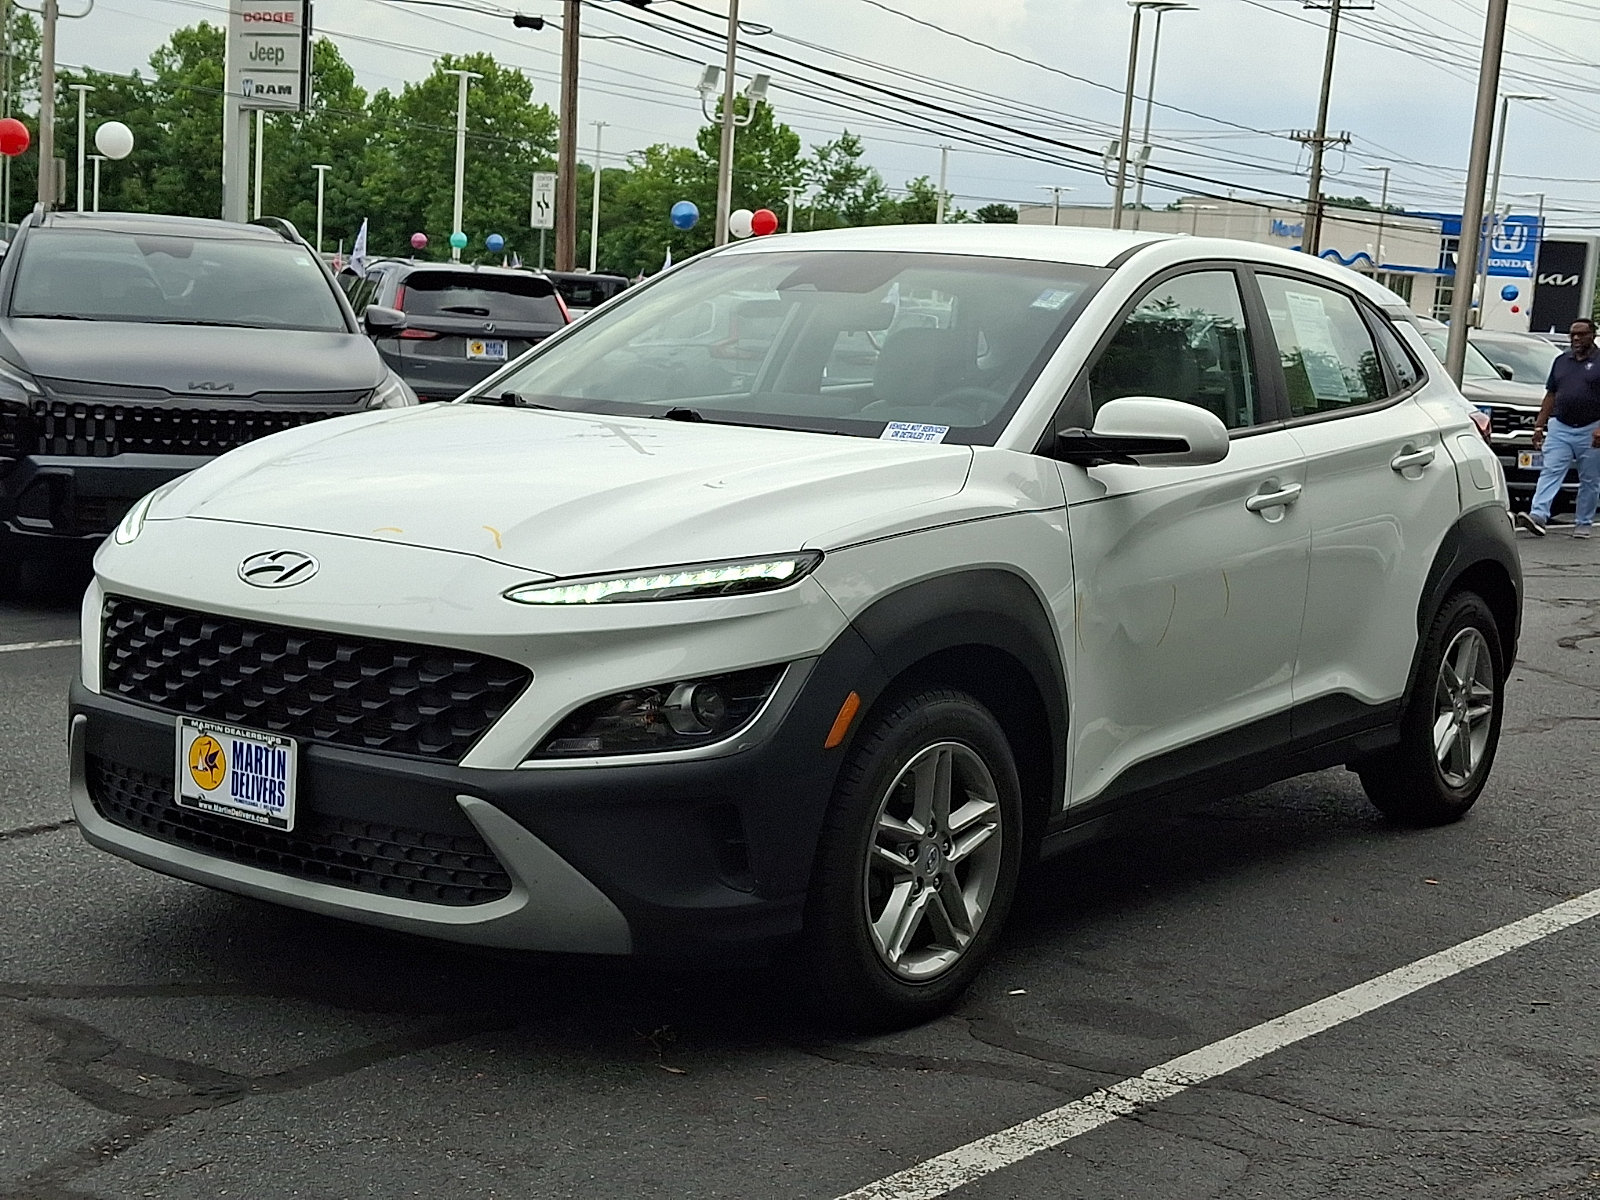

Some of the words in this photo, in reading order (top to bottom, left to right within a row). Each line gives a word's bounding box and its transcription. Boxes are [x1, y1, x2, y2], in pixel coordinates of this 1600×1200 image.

[243, 12, 294, 22] DODGE
[249, 41, 285, 66] Jeep
[255, 84, 292, 95] RAM
[1538, 273, 1579, 286] KIA
[889, 423, 911, 431] VEHICLE
[911, 424, 923, 432] NOT
[191, 720, 224, 733] MARTIN
[224, 724, 282, 745] DEALERSHIPS
[232, 740, 287, 781] MARTIN
[231, 770, 286, 808] DELIVERS
[198, 802, 269, 824] www.MartinDelivers.com
